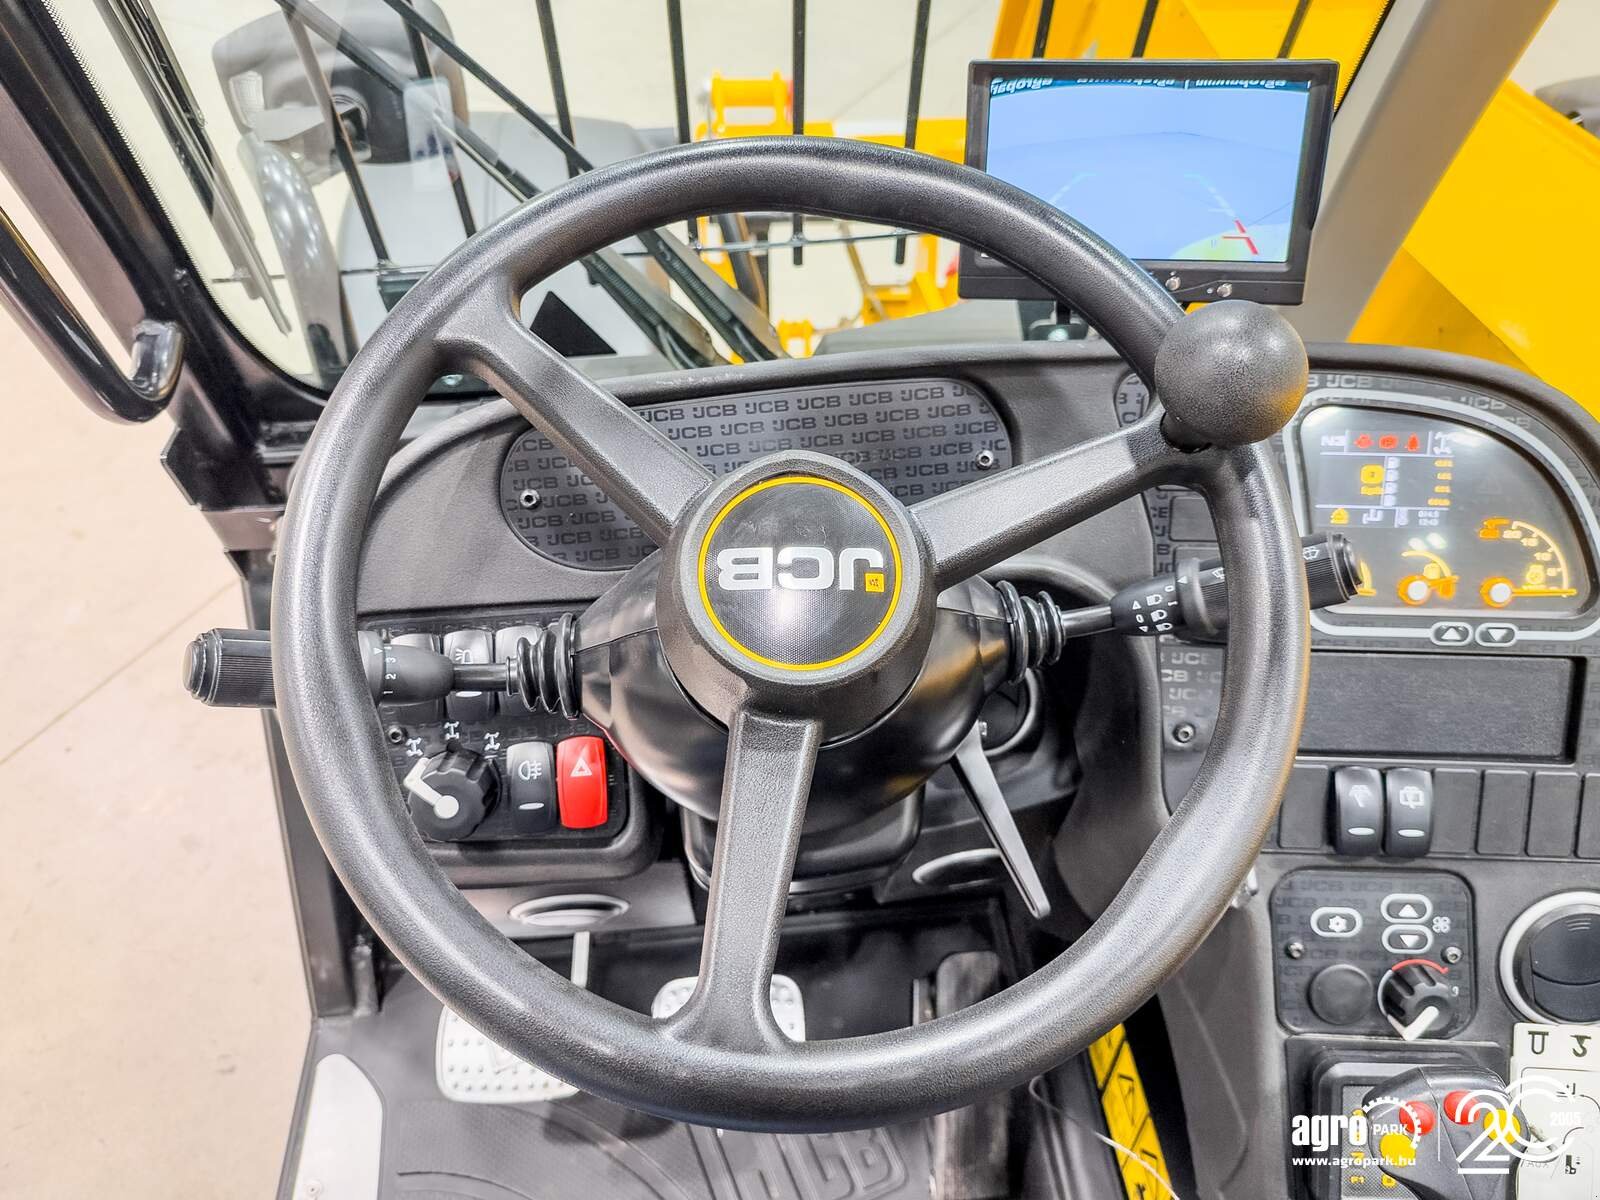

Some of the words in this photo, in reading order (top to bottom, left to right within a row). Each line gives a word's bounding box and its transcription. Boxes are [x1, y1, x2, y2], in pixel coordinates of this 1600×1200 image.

[693, 404, 737, 419] JCB
[745, 400, 789, 415] JCB
[797, 395, 841, 410] JCB
[849, 391, 893, 406] JCB
[901, 387, 945, 401] JCB
[668, 426, 712, 441] JCB
[720, 421, 764, 436] JCB
[773, 417, 817, 432] JCB
[824, 412, 868, 427] JCB
[876, 408, 920, 423] JCB
[928, 404, 971, 419] JCB
[697, 443, 741, 457] JCB
[749, 438, 792, 453] JCB
[801, 434, 844, 449] JCB
[852, 429, 895, 444] JCB
[903, 425, 947, 440] JCB
[954, 421, 998, 436] JCB
[930, 442, 973, 457] JCB
[905, 463, 949, 478] JCB
[513, 477, 558, 491] JCB
[518, 515, 563, 530] JCB
[571, 511, 616, 525] JCB
[547, 531, 592, 545] JCB
[575, 549, 620, 563] JCB
[716, 546, 885, 593] JCB
